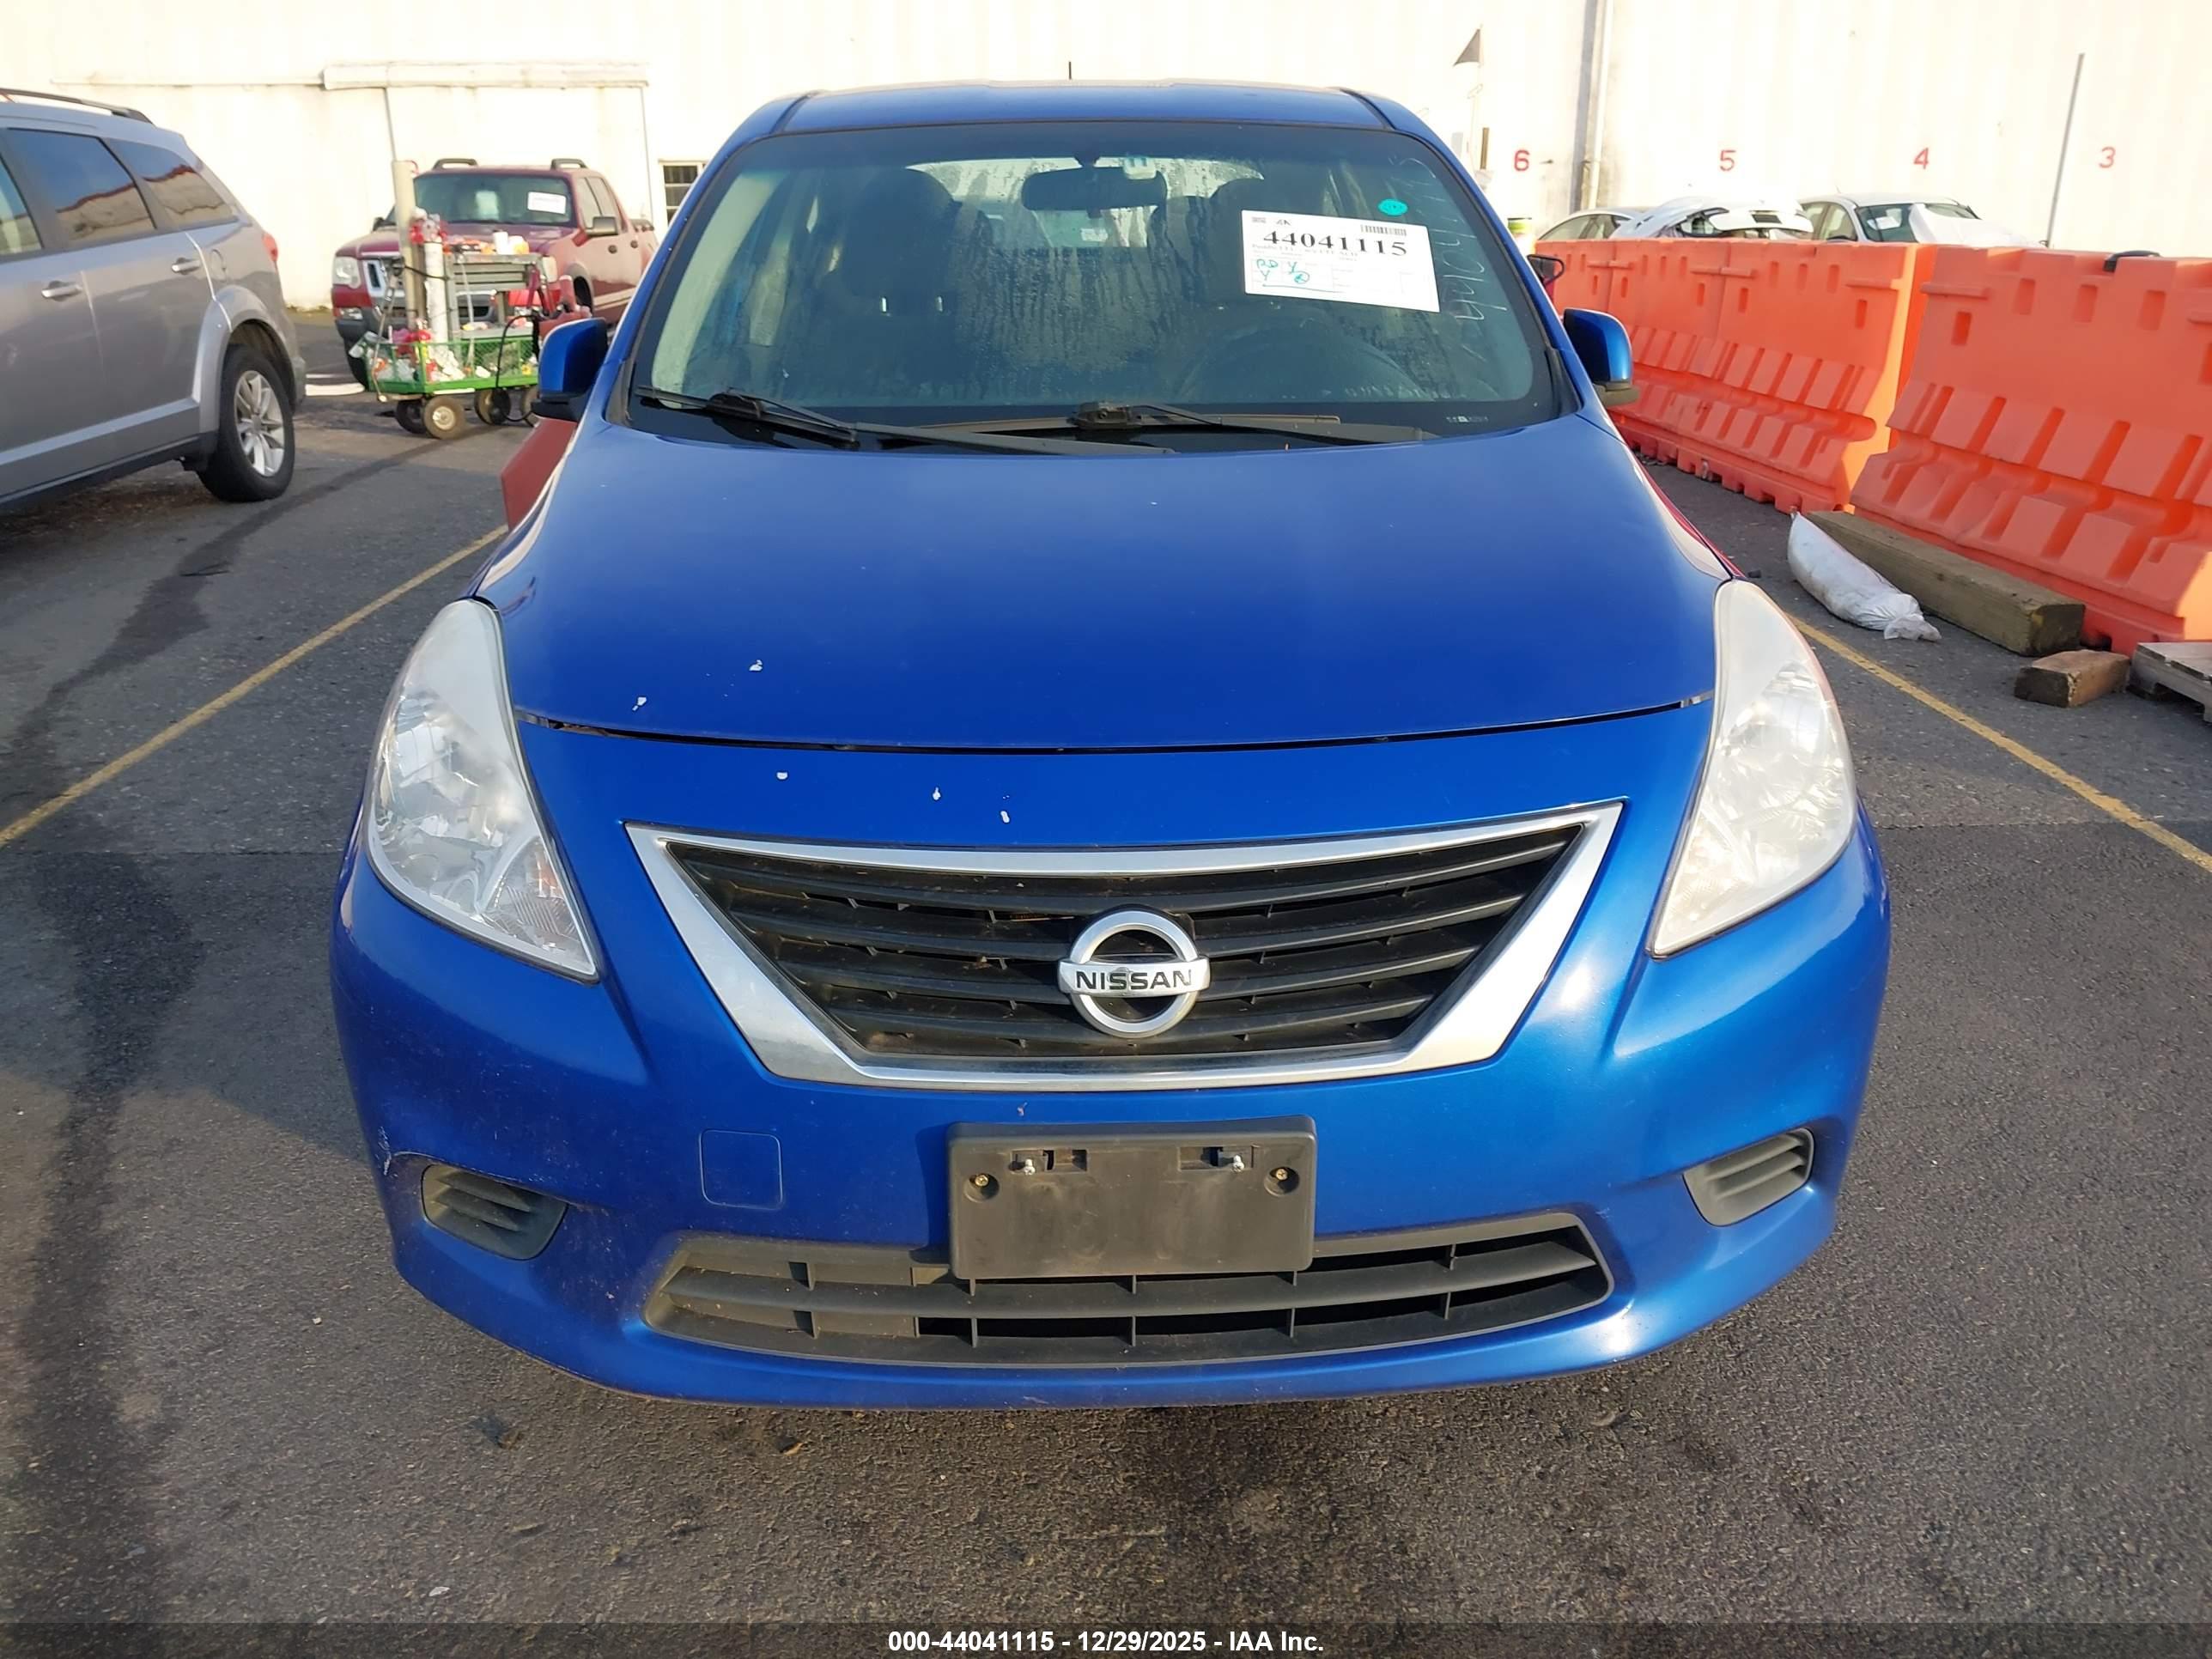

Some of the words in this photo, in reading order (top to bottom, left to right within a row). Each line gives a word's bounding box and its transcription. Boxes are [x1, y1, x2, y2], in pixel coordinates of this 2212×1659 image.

[1513, 149, 1530, 173] 6
[1719, 149, 1736, 172] 5
[1913, 147, 1930, 170] 4
[2099, 146, 2117, 169] 3
[1263, 230, 1407, 257] 44041115
[1075, 969, 1193, 990] NISSAN
